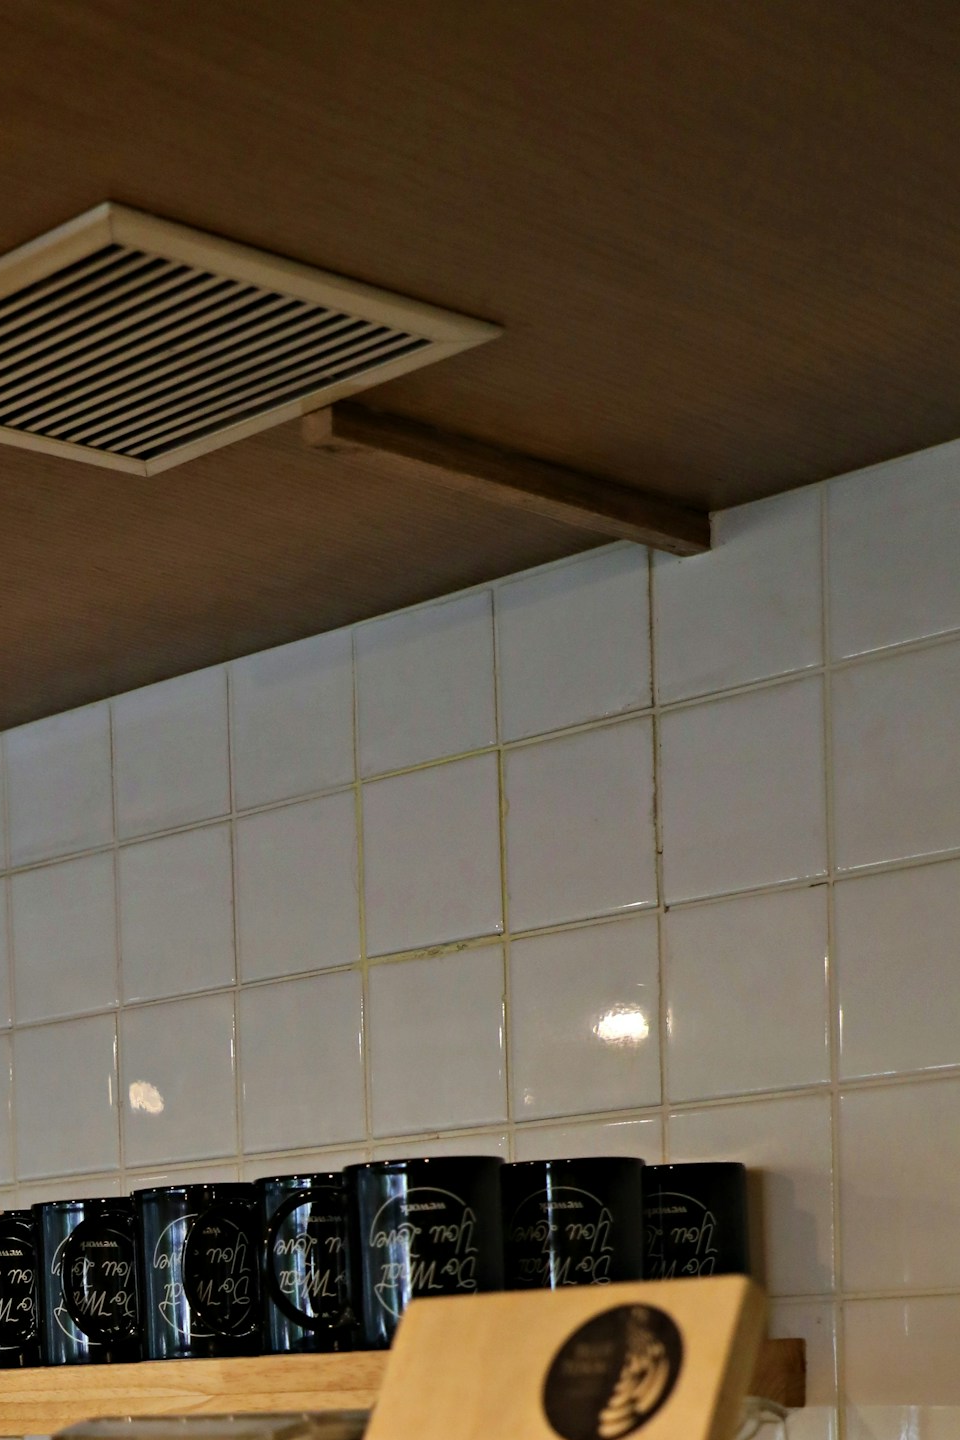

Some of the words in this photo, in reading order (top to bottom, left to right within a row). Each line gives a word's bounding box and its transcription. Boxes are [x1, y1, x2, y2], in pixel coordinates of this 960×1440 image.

[375, 1259, 444, 1293] What
[441, 1256, 478, 1288] Do
[159, 1278, 221, 1311] Wat
[218, 1275, 251, 1305] Do
